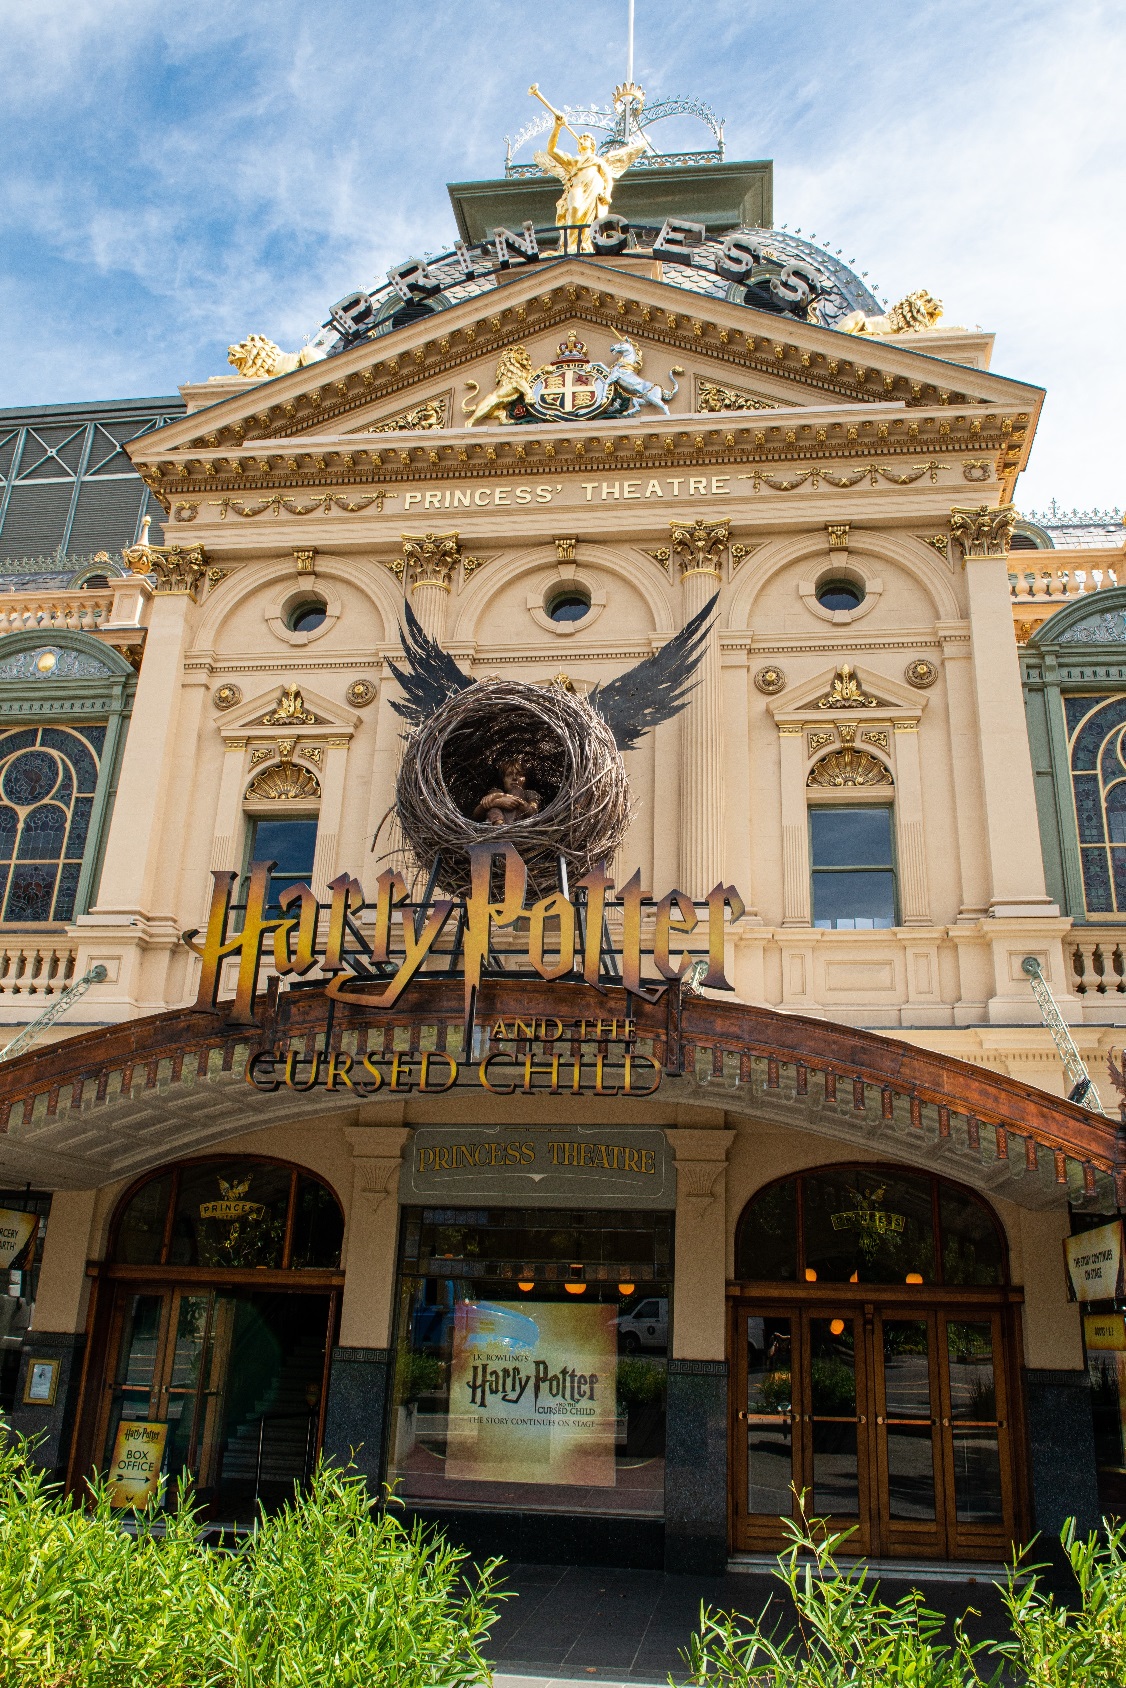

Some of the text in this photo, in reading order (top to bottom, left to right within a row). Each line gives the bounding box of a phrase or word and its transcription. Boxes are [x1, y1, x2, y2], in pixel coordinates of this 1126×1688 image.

[328, 213, 822, 342] PRINCESS
[404, 475, 731, 510] PRINCESS' THEATRE
[182, 842, 746, 1052] Harry Potter
[490, 1017, 638, 1041] AND THE
[245, 1049, 663, 1097] CURSED CHILD
[417, 1142, 656, 1174] PRINCESS THEATRE
[204, 1203, 261, 1214] PRINCESS
[466, 1360, 599, 1413] Harry Potter
[469, 1416, 483, 1424] THE
[485, 1417, 509, 1425] STORY
[510, 1418, 555, 1427] CONTINUES
[572, 1420, 596, 1428] STAGE
[537, 1406, 596, 1416] CURSED CHILD
[124, 1427, 160, 1441] Harry Potter
[118, 1460, 155, 1472] OFFICE
[126, 1450, 149, 1460] BOX
